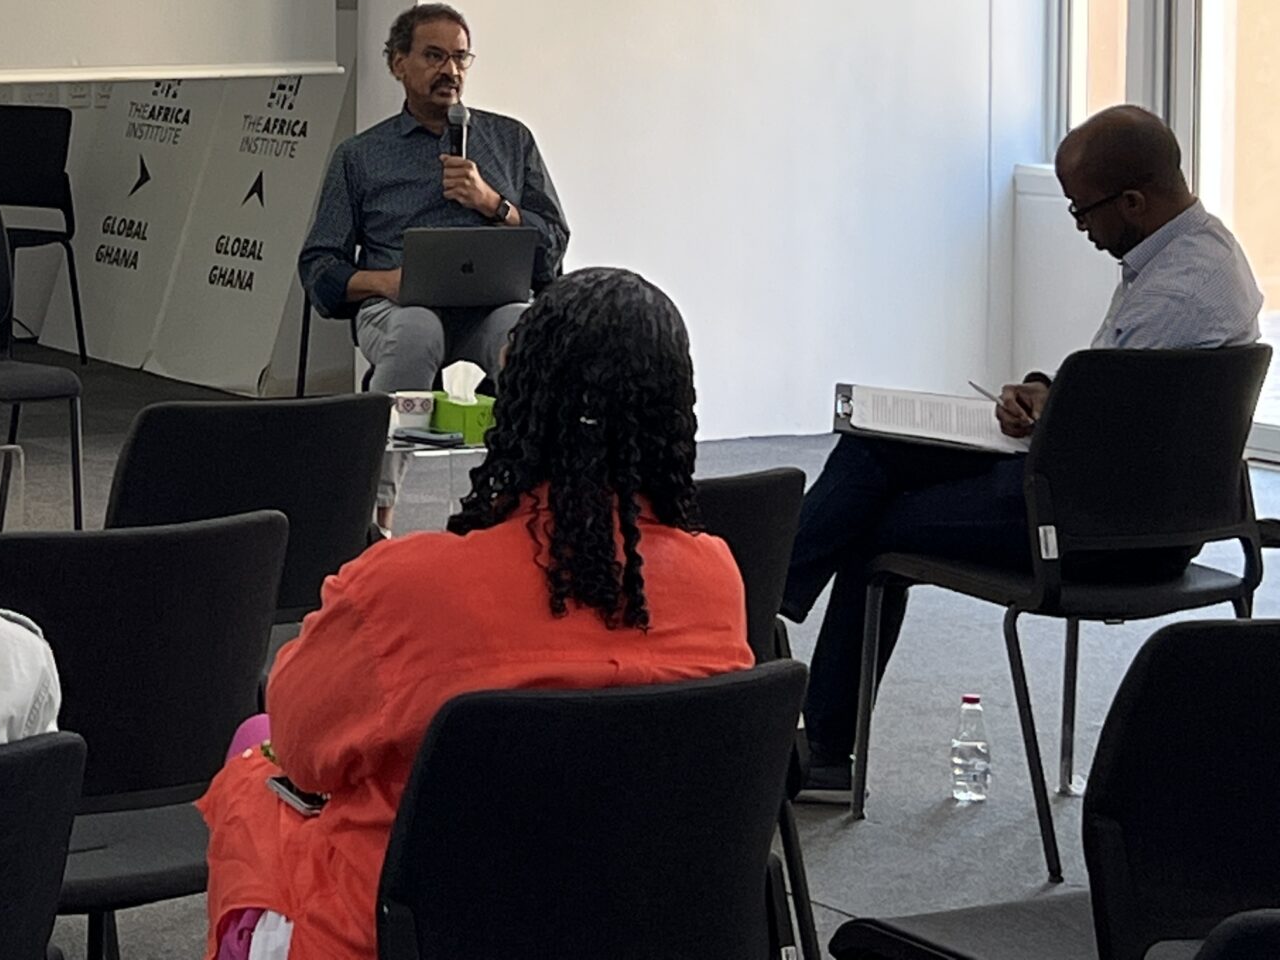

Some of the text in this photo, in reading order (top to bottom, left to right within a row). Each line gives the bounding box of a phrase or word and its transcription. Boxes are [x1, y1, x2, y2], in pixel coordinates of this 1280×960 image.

[126, 122, 182, 144] INSTITUTE
[239, 136, 299, 158] INSTITUTE
[102, 215, 148, 240] GLOBAL
[95, 244, 139, 270] GHANA
[215, 234, 264, 260] GLOBAL
[208, 266, 254, 291] GHANA
